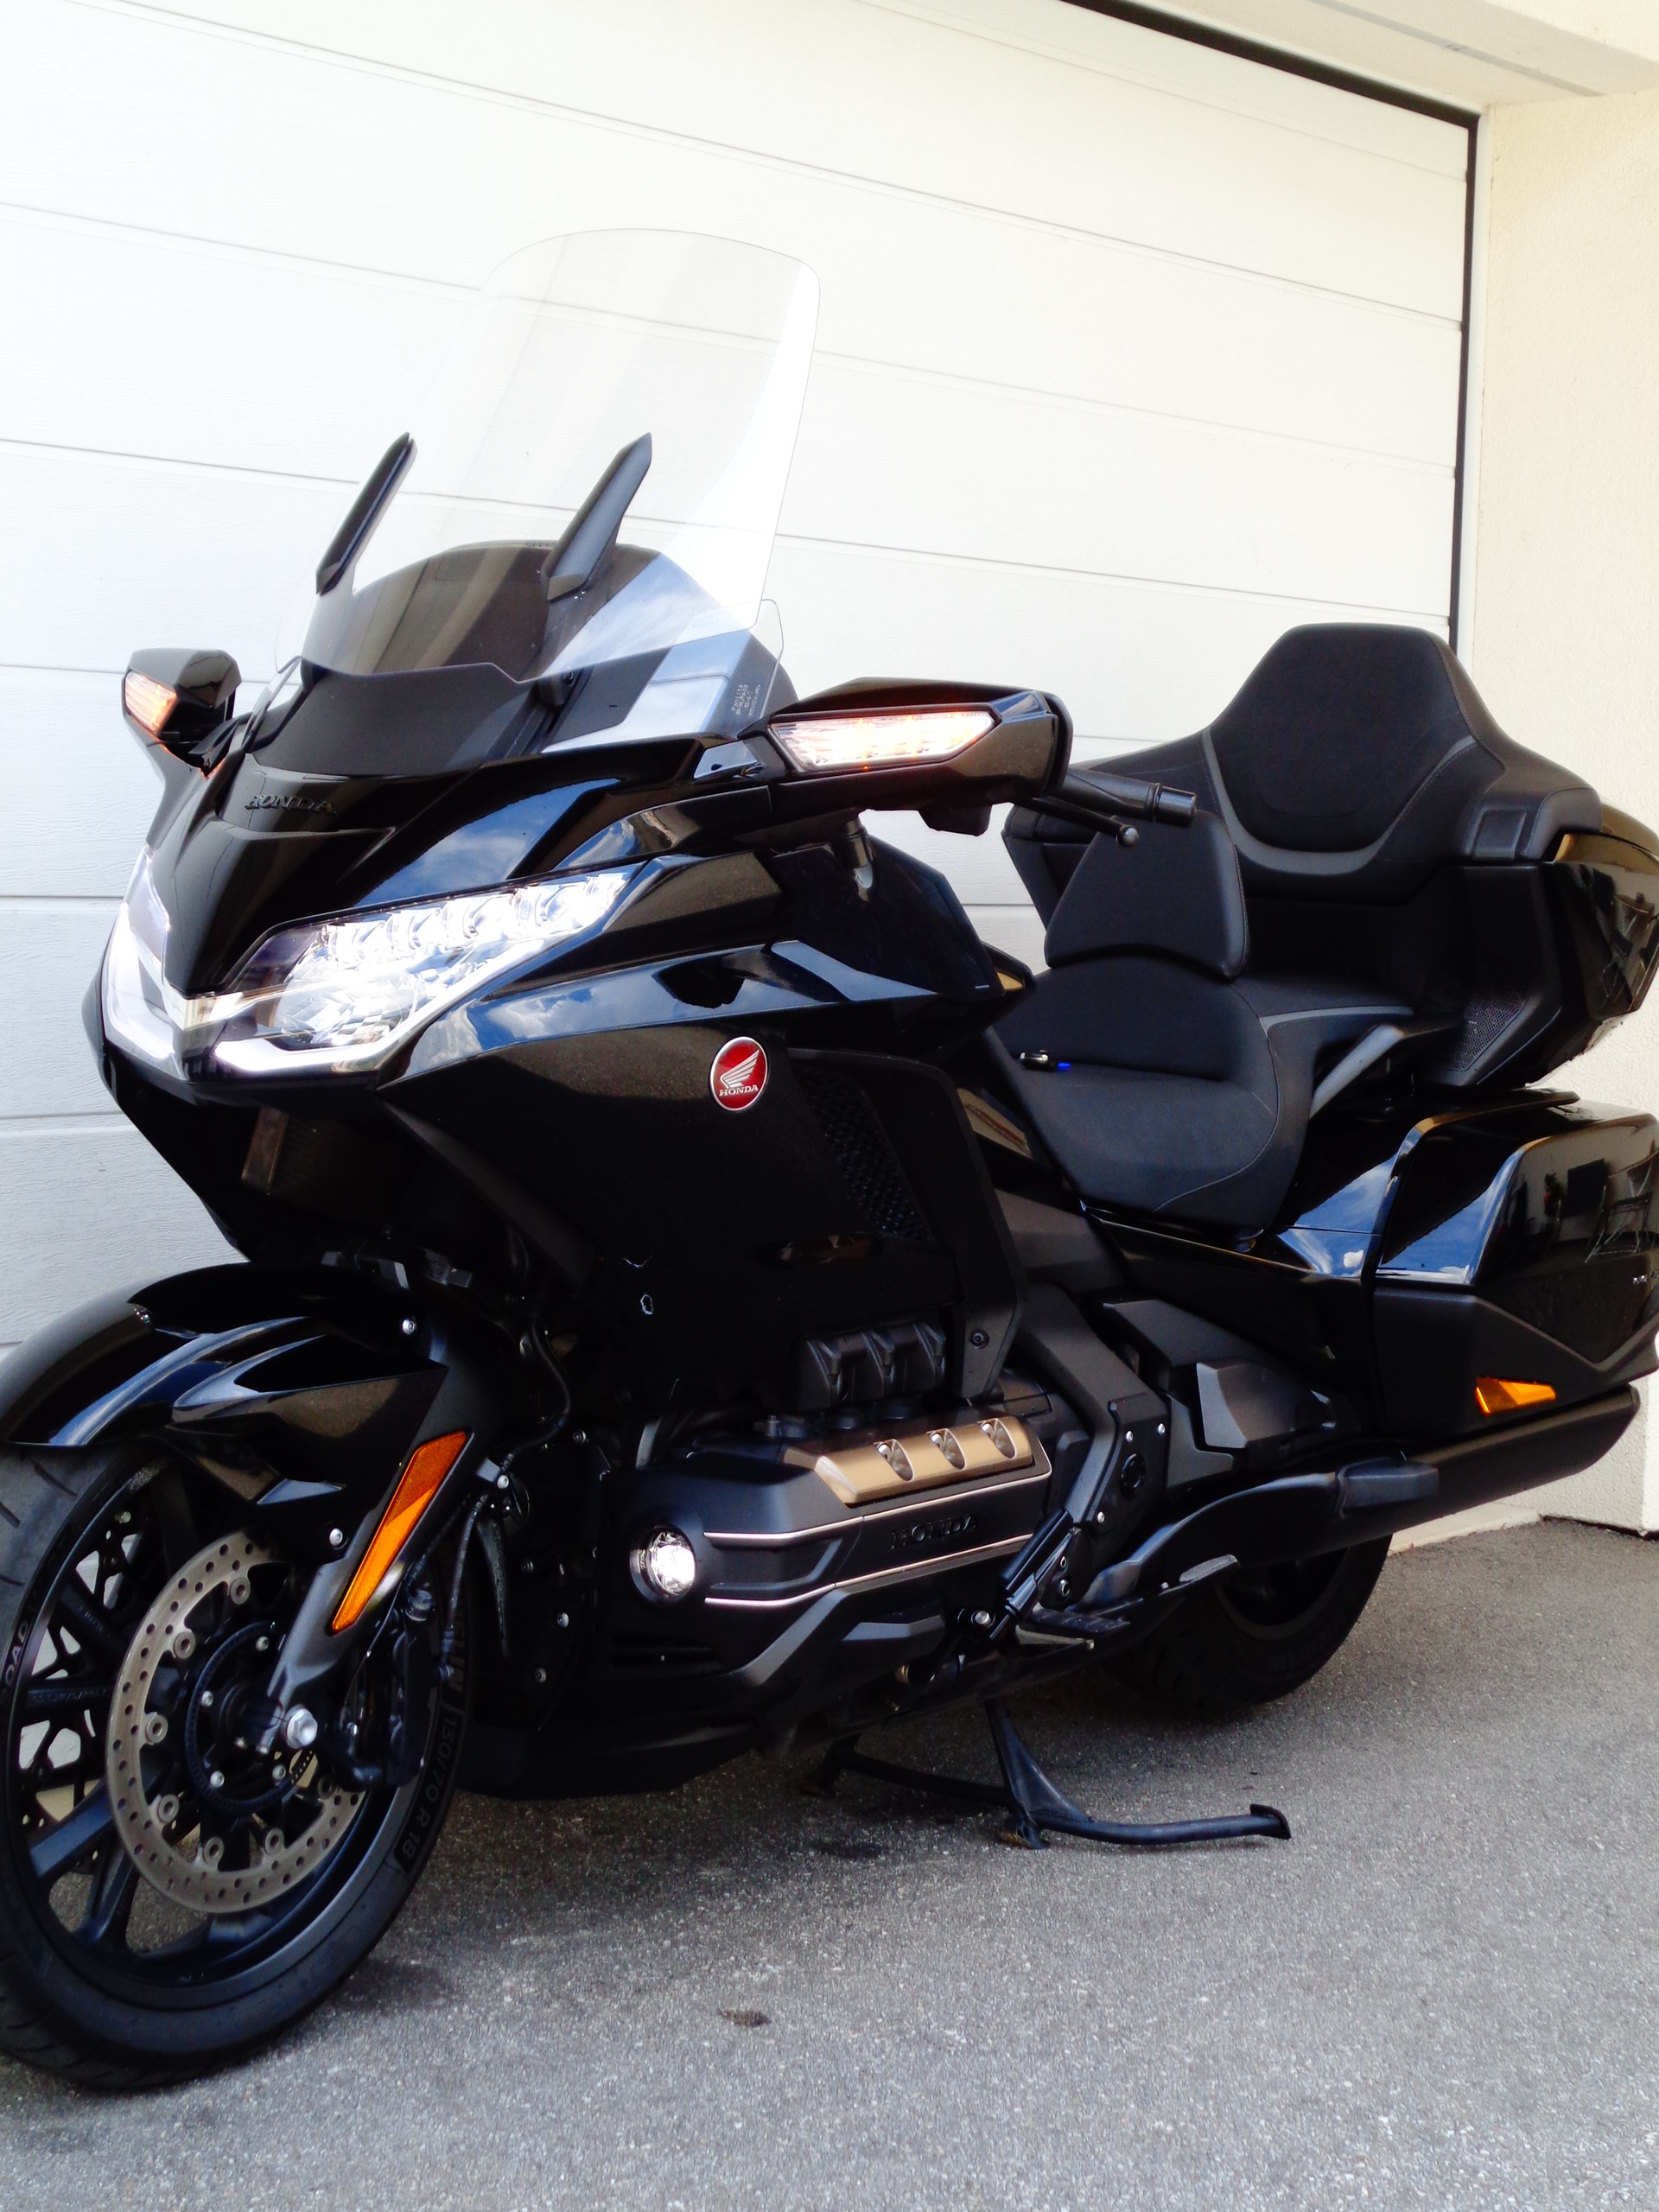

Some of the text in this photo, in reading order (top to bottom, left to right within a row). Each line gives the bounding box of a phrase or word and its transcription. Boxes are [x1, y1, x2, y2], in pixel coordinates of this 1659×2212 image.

[245, 795, 336, 815] HONDA
[719, 1085, 759, 1096] HONDA
[890, 1515, 978, 1549] HONDA
[402, 1717, 457, 1859] 130/70 R 18
